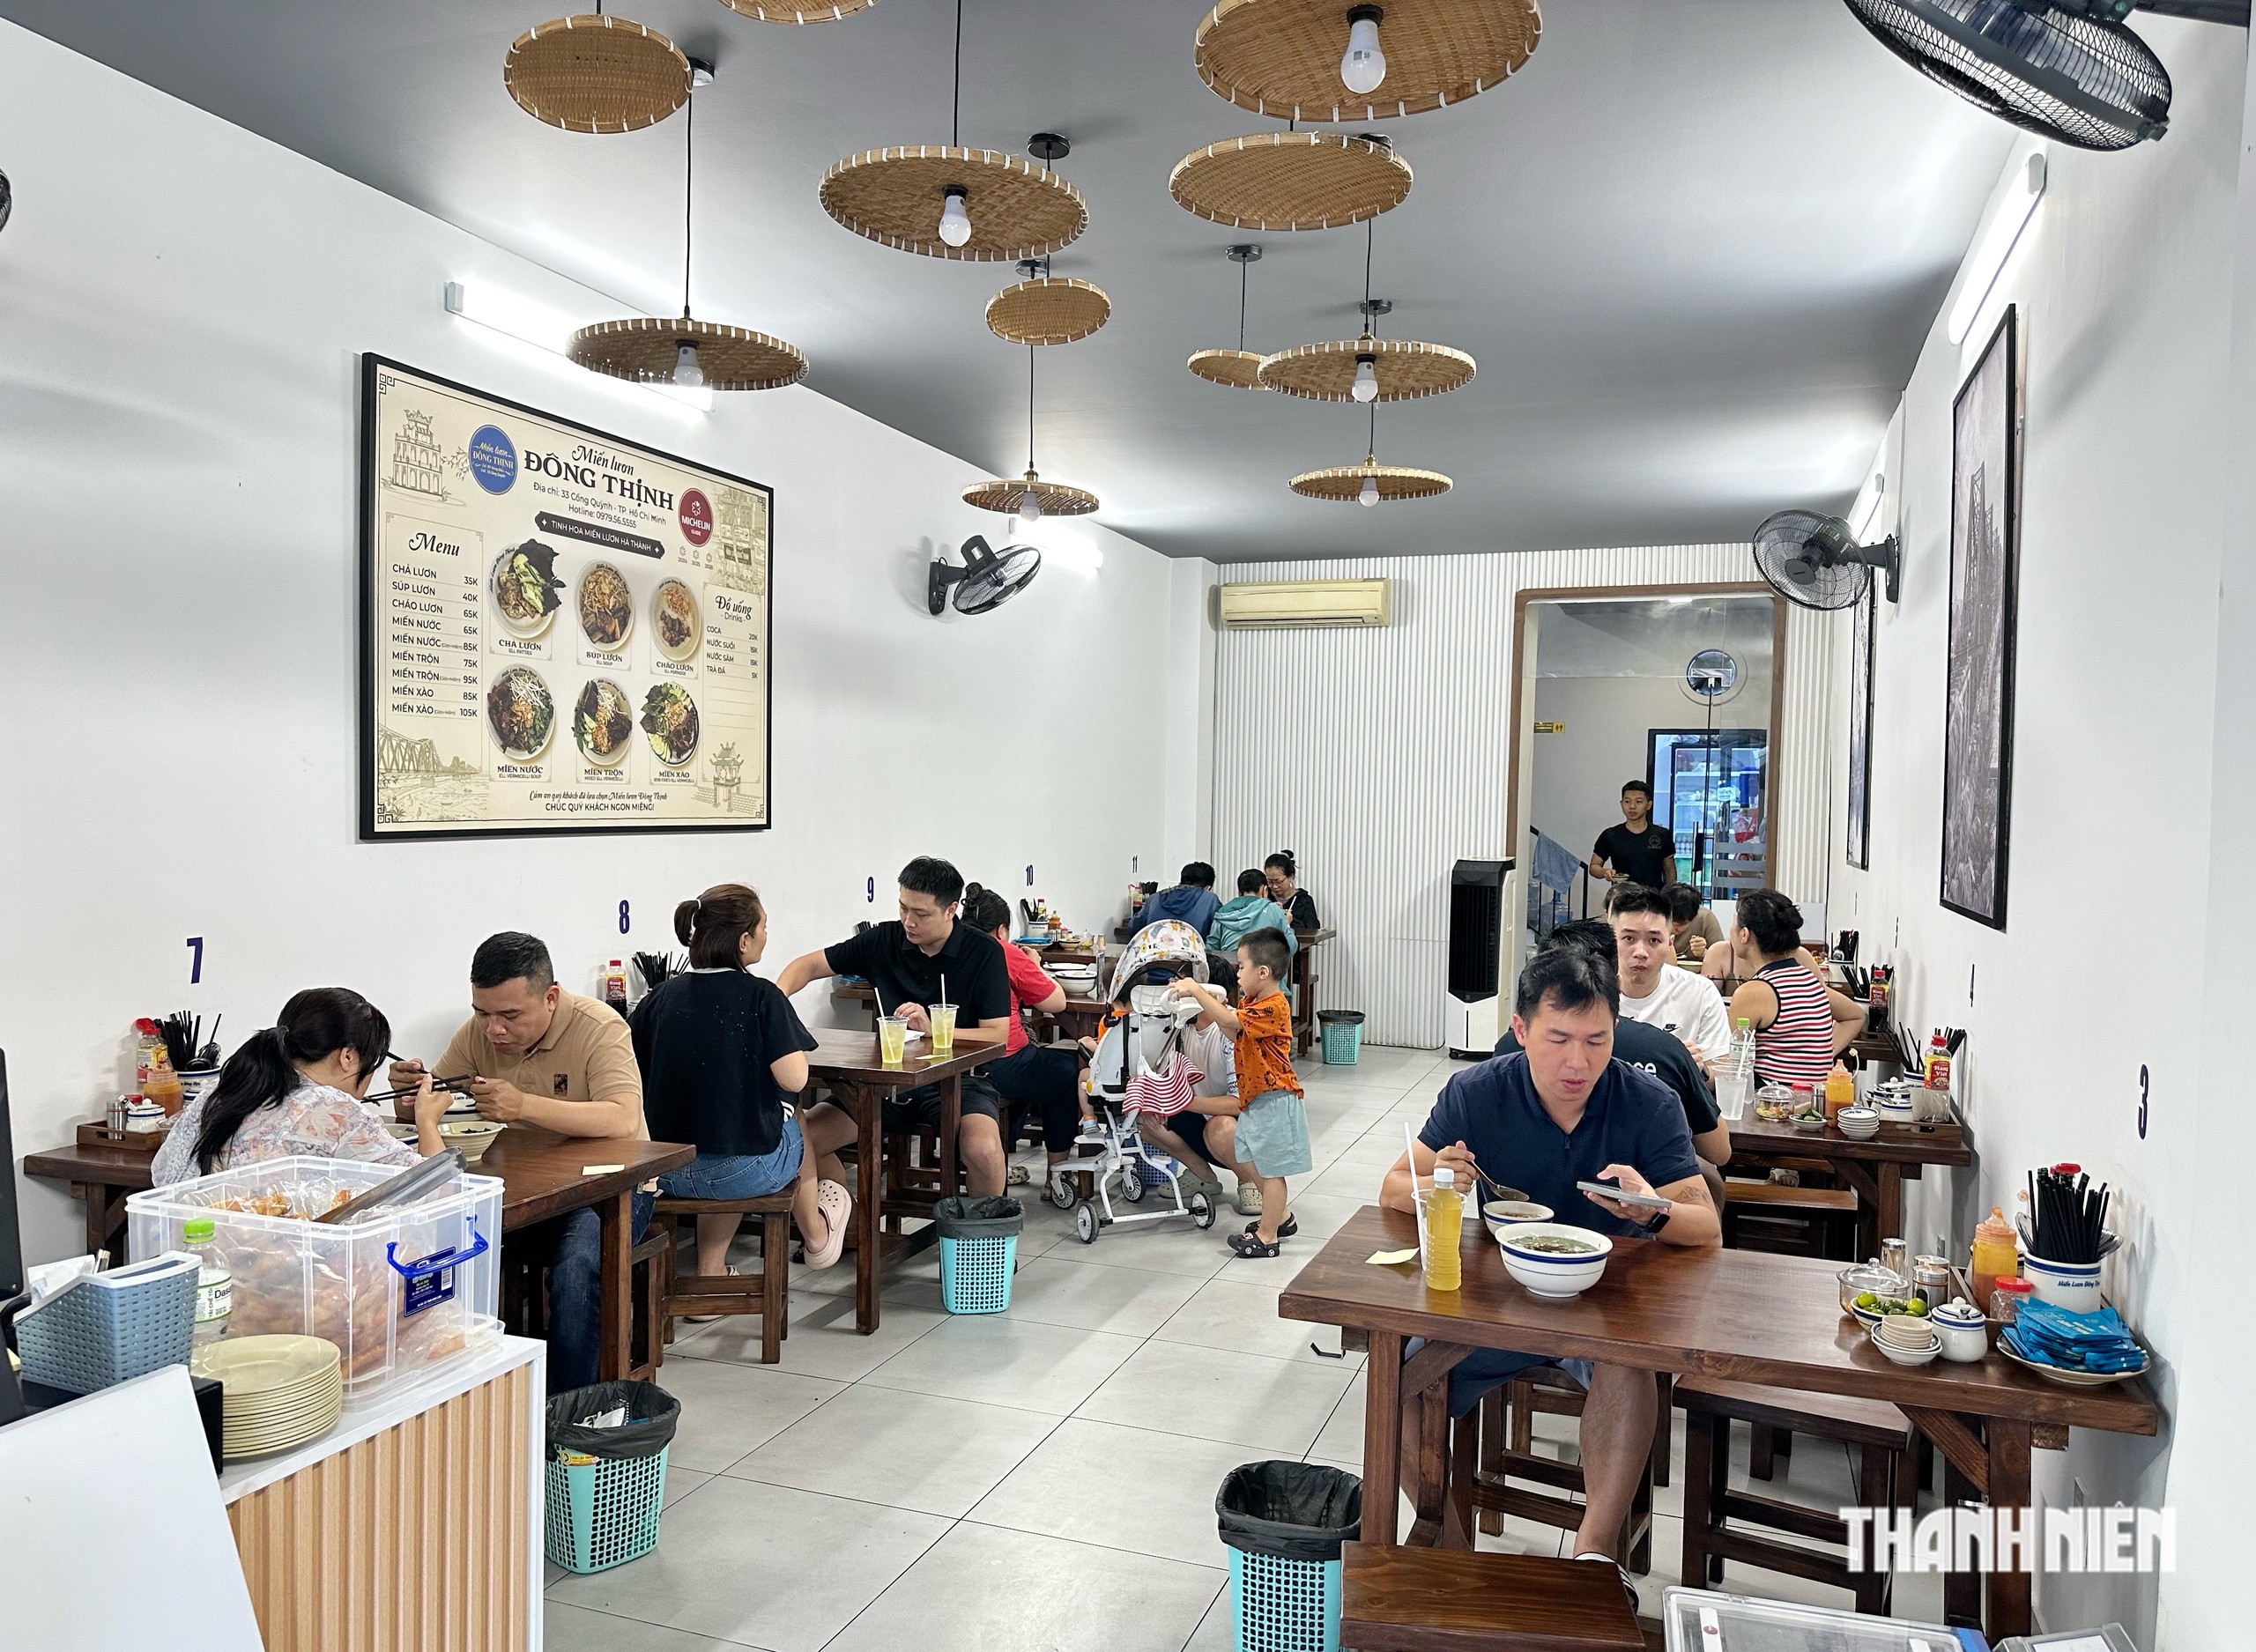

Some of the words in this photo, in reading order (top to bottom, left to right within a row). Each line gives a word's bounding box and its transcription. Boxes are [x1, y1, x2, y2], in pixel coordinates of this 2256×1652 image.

[571, 445, 608, 468] Miến
[610, 456, 634, 476] lươn
[524, 449, 596, 488] ĐÔNG
[602, 473, 673, 511] THỊNH
[533, 481, 546, 493] Địa
[560, 489, 569, 500] 33
[570, 493, 589, 506] Cống
[590, 497, 612, 510] Quỳnh
[618, 505, 627, 514] TP.
[650, 515, 666, 526] Minh
[568, 503, 595, 518] Hotline:
[596, 511, 636, 529] 0979.56.5555
[681, 515, 710, 530] MICHELIN
[408, 532, 460, 556] Menu
[552, 520, 568, 531] TINH
[568, 524, 583, 536] HOA
[584, 529, 600, 539] MIẾN
[602, 533, 620, 544] LƯƠN
[620, 536, 630, 546] HÀ
[630, 538, 651, 552] THÀNH
[392, 563, 412, 575] CHẢ
[413, 567, 437, 579] LƯƠN
[464, 575, 479, 587] 35K
[392, 581, 410, 591] SÚP
[412, 584, 435, 596] LƯƠN
[463, 593, 479, 603] 40K
[392, 598, 418, 611] CHÁO
[419, 601, 443, 614] LƯƠN
[464, 609, 479, 619] 65K
[715, 595, 732, 611] Đồ
[732, 599, 753, 620] uống
[724, 611, 743, 623] Drinks
[392, 615, 414, 627] MIẾN
[416, 619, 442, 631] NƯỚC
[464, 626, 479, 635] 65K
[706, 626, 722, 634] COCA
[748, 633, 758, 641] 20K
[392, 633, 414, 645] MIẾN
[416, 636, 442, 648] NƯỚC
[463, 642, 479, 652] 85K
[518, 641, 542, 651] LƯƠN
[706, 638, 723, 648] NƯỚC
[723, 641, 736, 650] SUỐI
[392, 649, 414, 662] MIẾN
[416, 653, 440, 665] TRỘN
[464, 659, 479, 669] 75K
[586, 651, 601, 660] SÚP
[602, 652, 623, 663] LƯƠN
[706, 652, 723, 661] NƯỚC
[392, 667, 414, 678] MIẾN
[416, 670, 440, 682] TRỘN
[463, 675, 479, 685] 95K
[656, 661, 676, 670] CHÁO
[676, 663, 694, 672] LƯƠN
[706, 665, 717, 674] TRÀ
[717, 666, 726, 675] ĐÁ
[392, 685, 414, 696] MIẾN
[416, 685, 434, 697] XÀO
[463, 692, 479, 701] 85K
[391, 701, 414, 714] MIẾN
[416, 703, 434, 715] XÀO
[459, 707, 479, 718] 105K
[519, 765, 544, 774] NƯỚC
[583, 767, 603, 776] MIẾN
[604, 768, 624, 778] TRỘN
[545, 801, 567, 811] CHÚC
[568, 802, 583, 812] QUÝ
[584, 802, 609, 811] KHÁCH
[610, 803, 631, 811] NGON
[632, 802, 655, 812] MIỆNG!
[1132, 855, 1138, 873] 11
[1025, 864, 1034, 886] 10
[867, 876, 874, 903] 9
[619, 900, 630, 934] 8
[186, 937, 204, 984] 7
[2138, 1063, 2148, 1140] 3
